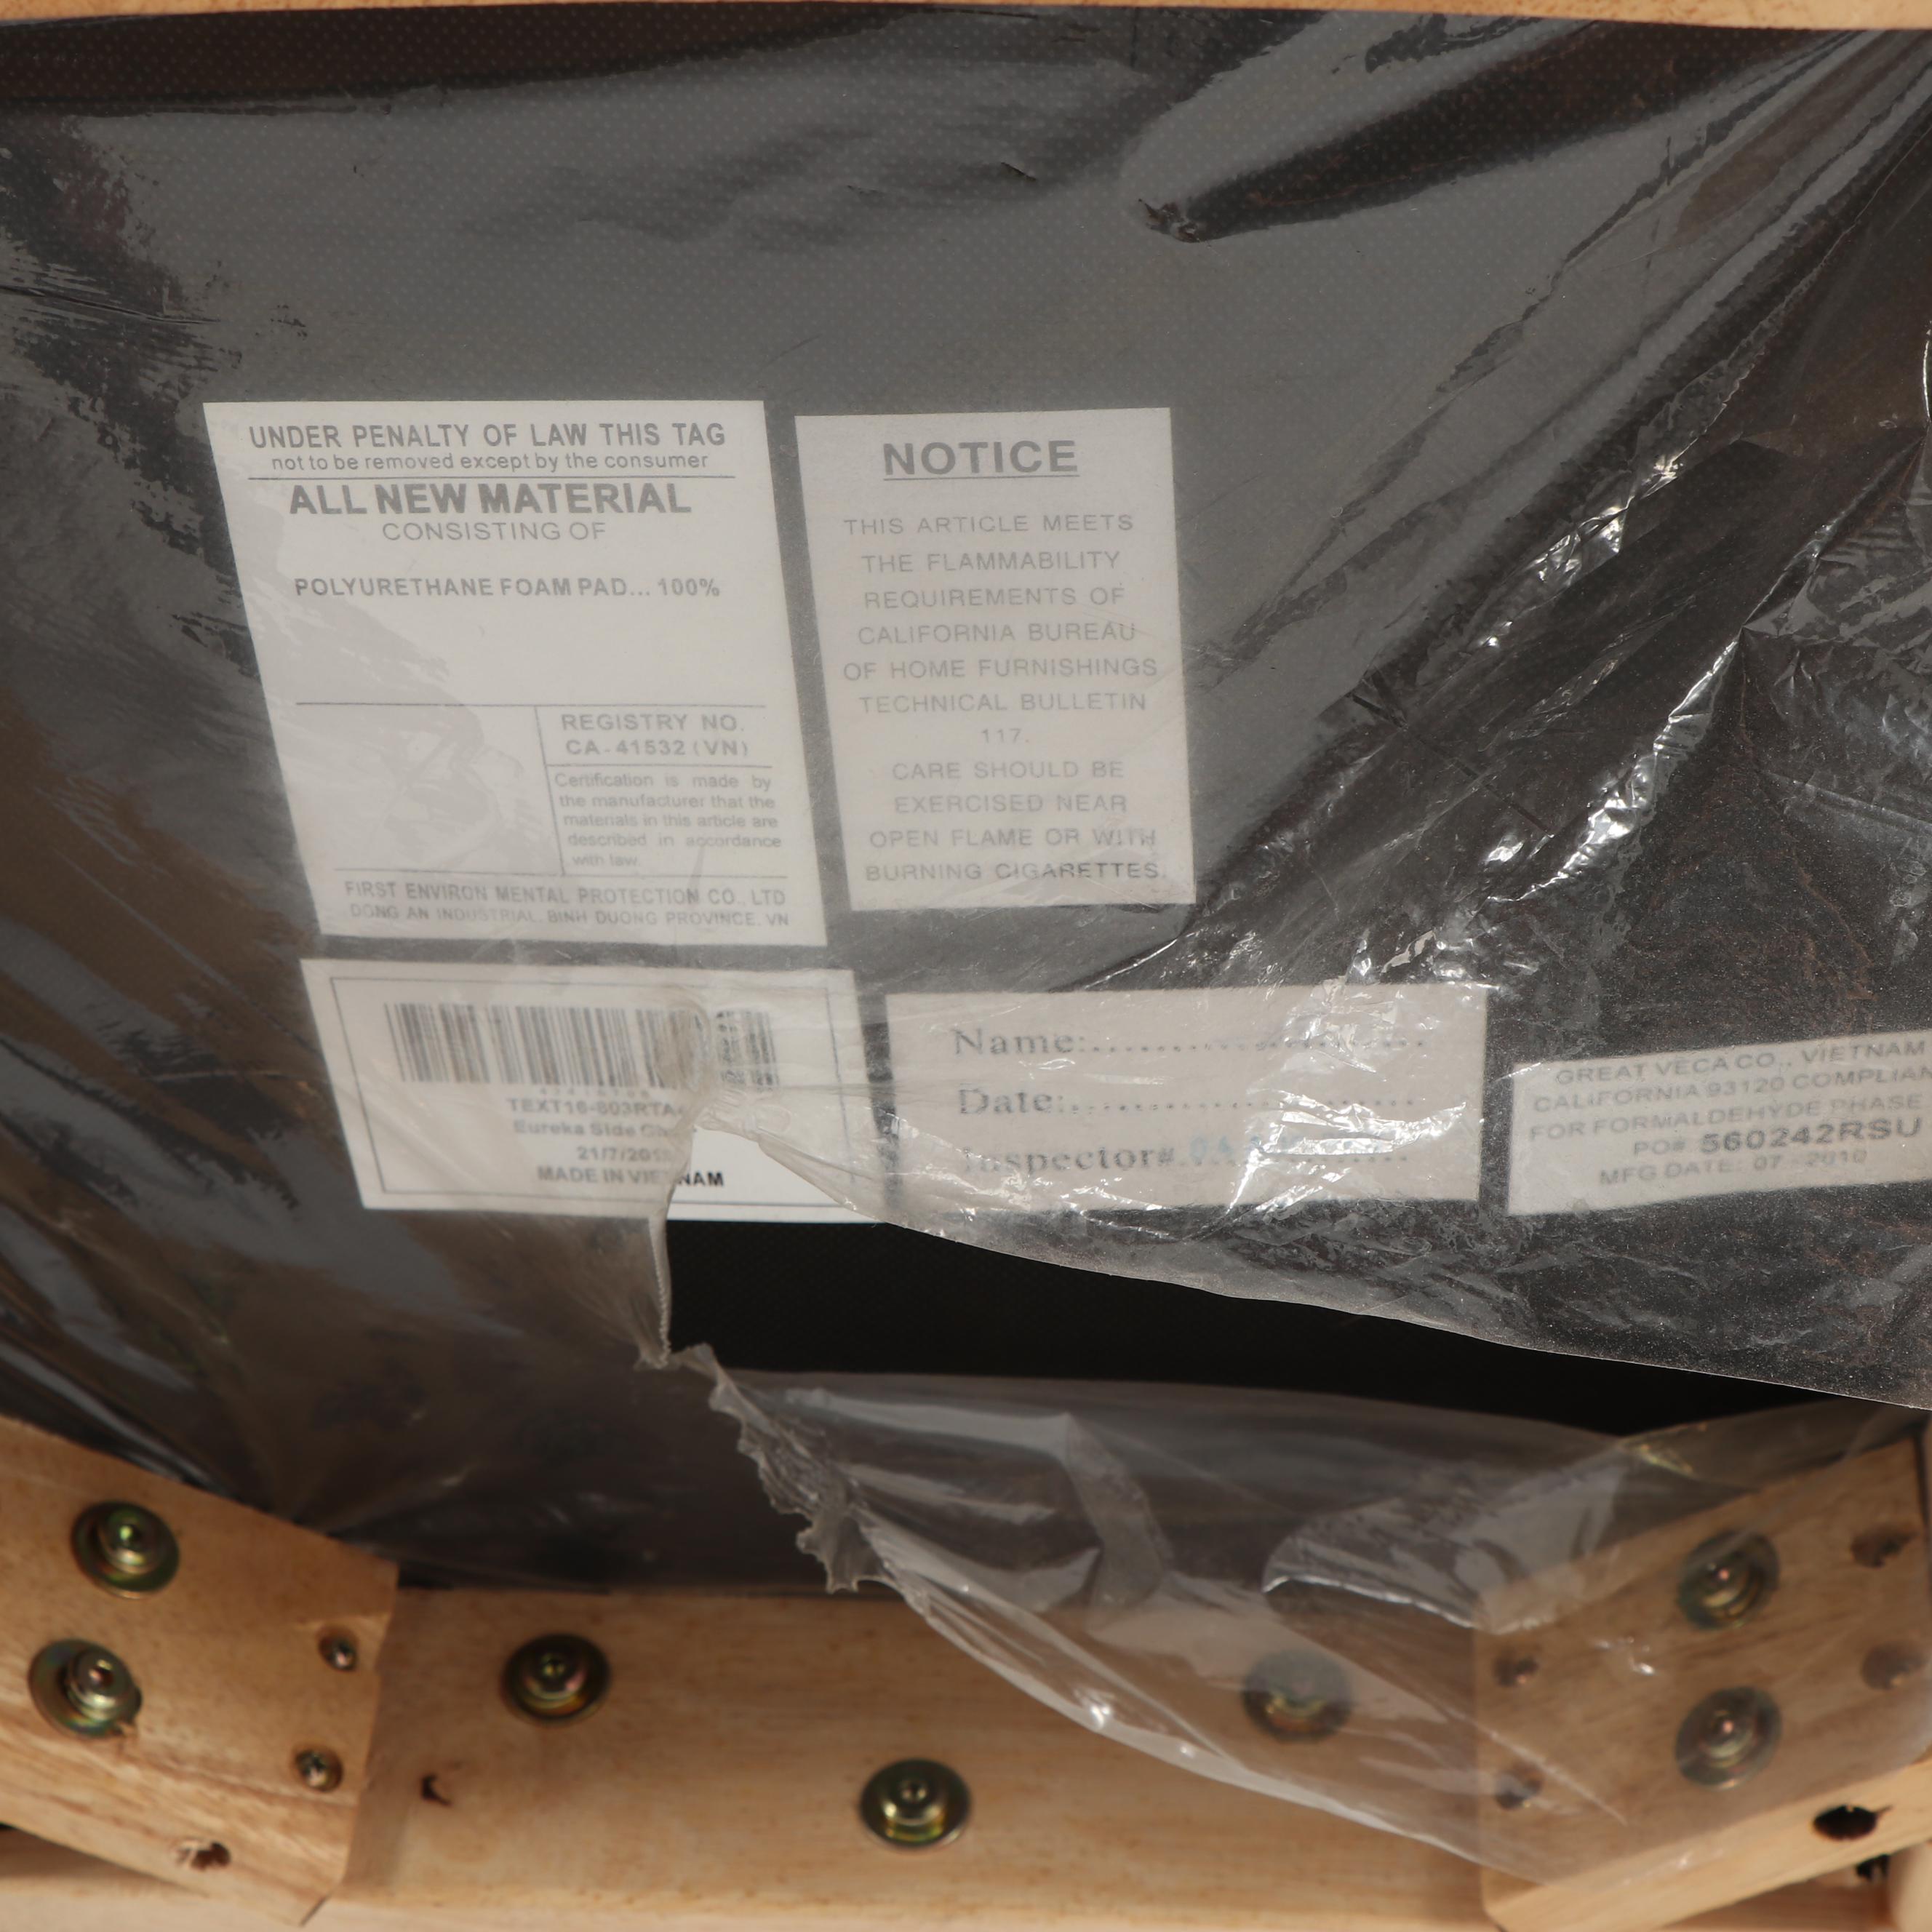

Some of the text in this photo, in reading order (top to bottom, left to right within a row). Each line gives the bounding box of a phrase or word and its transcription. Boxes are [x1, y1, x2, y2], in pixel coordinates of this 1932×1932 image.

[249, 422, 726, 448] UNDER PENALTY OF LAW THIS TAG
[272, 452, 710, 473] not to be removed except by the consumer
[882, 439, 1079, 475] NOTICE
[289, 482, 692, 515] ALL NEW MATERIAL
[382, 522, 607, 541] CONSISTING OF
[844, 513, 1135, 535] THIS ARTICLE MEETS
[861, 550, 1121, 572] THE FLAMMABILITY
[295, 577, 495, 597] POLYURETHANE
[501, 577, 572, 597] FOAM
[659, 578, 721, 597] 100%
[864, 586, 1126, 609] REQUIREMENTS OF
[858, 622, 1137, 645] CALIFORNIA BUREAU
[843, 657, 1158, 681] OF HOME FURNISHINGS
[860, 692, 1146, 714] TECHNICAL BULLETIN
[561, 713, 745, 732] REGISTRY NO.
[892, 760, 1125, 781] CARE SHOULD BE
[554, 772, 772, 791] Certification is made by
[559, 794, 776, 810] the manufacturer that the
[894, 794, 1127, 814] EXERCISED NEAR
[563, 813, 778, 829] materials in this article are
[567, 832, 782, 848] described in accordance
[869, 828, 1157, 849] OPEN FLAME OR WITH
[571, 853, 604, 867] with
[866, 865, 982, 882] BURNING
[344, 881, 397, 898] FIRST
[405, 882, 487, 901] ENVIRON
[495, 885, 569, 903] MENTAL
[578, 887, 699, 905] PROTECTION
[752, 889, 786, 906] LTD
[351, 904, 399, 919] DONG
[406, 906, 429, 920] AN
[595, 910, 658, 925] DUONG
[767, 912, 789, 926] VN
[1556, 1063, 1646, 1085] GREAT
[1654, 1055, 1731, 1077] VECA
[1800, 1040, 1925, 1063] VIETNAM
[1533, 1083, 1703, 1112] CALIFORNIA
[1709, 1077, 1785, 1098] 93120
[1530, 1093, 1923, 1141] FOR FORMALDEHYDE PHASE
[513, 1120, 586, 1135] Eureka
[590, 1122, 636, 1138] Side
[1700, 1117, 1923, 1154] 560242RSU
[537, 1165, 724, 1186] MADE IN VIENAM
[1600, 1167, 1658, 1186] MFG
